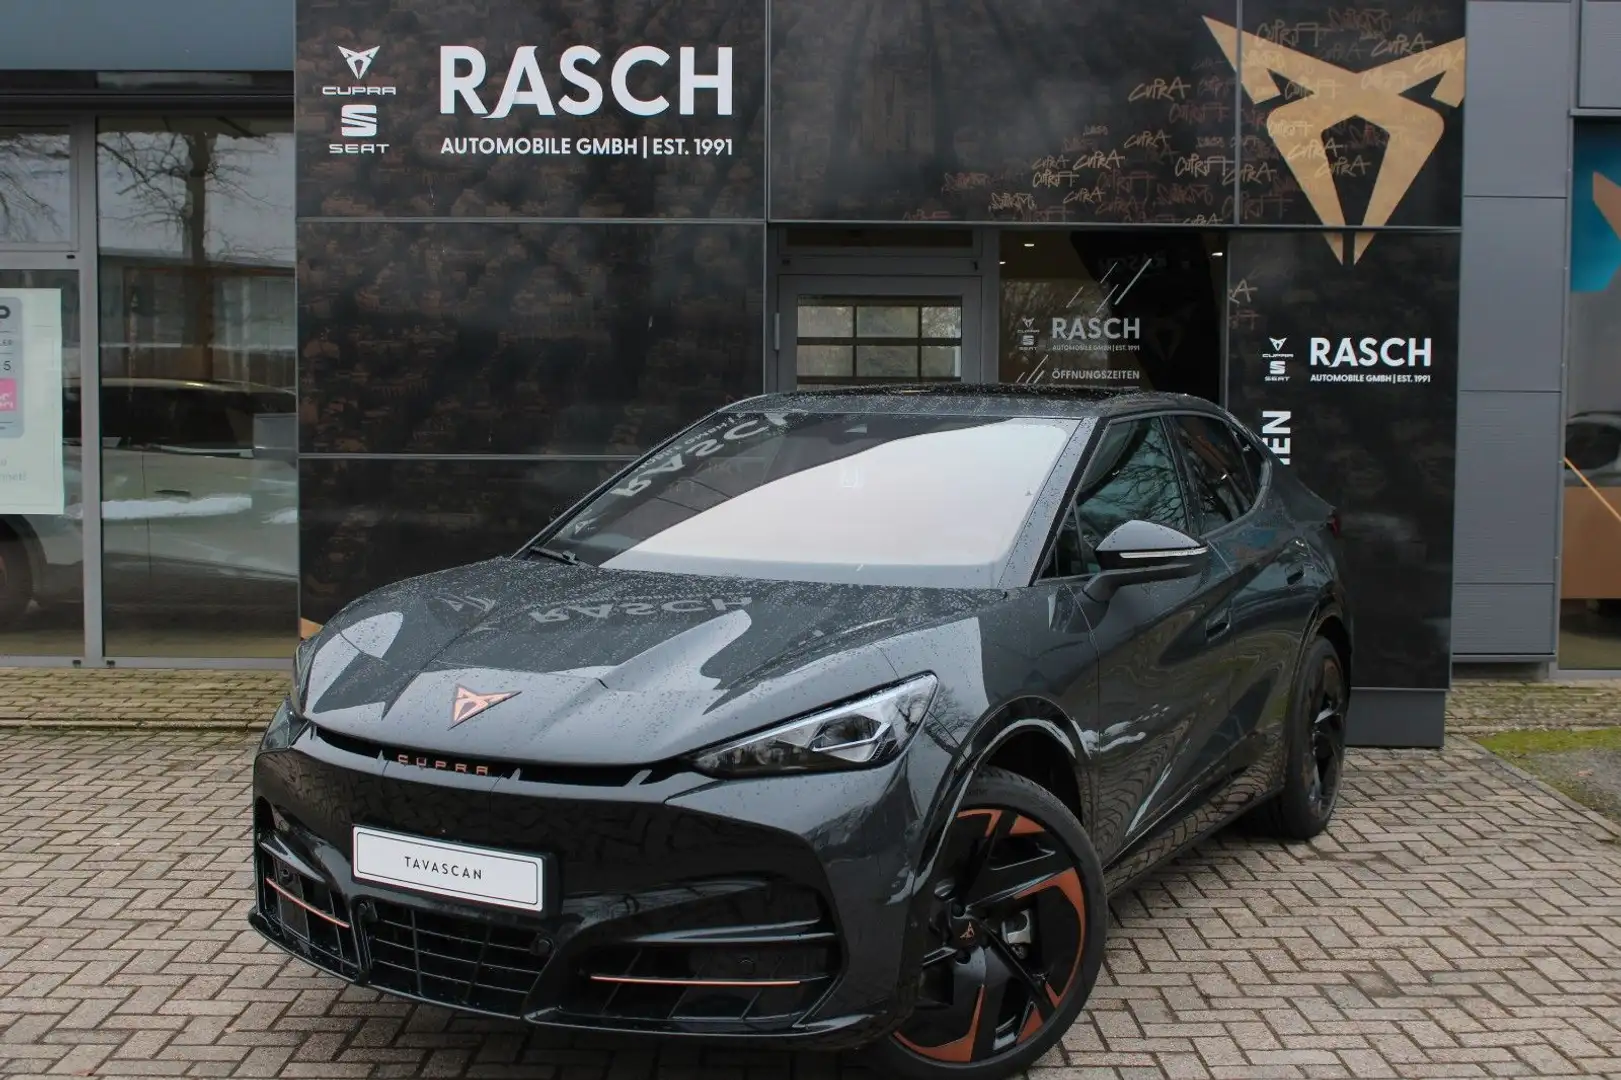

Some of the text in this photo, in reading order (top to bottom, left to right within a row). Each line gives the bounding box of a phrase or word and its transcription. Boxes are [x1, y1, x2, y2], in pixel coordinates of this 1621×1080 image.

[322, 86, 396, 95] CUPRA
[440, 45, 733, 118] RASCH
[1128, 76, 1191, 102] CUPRA
[329, 143, 389, 154] SEAT
[441, 137, 571, 155] AUTOMOBILE
[576, 137, 638, 155] GMBH
[653, 137, 690, 155] EST.
[694, 137, 733, 155] 1991
[1124, 130, 1172, 149] CUPRA
[1073, 150, 1125, 171] CUPRA
[1052, 317, 1140, 340] RASCH
[1310, 337, 1432, 368] RASCH
[1051, 367, 1140, 380] ÖFFNUNGSZEITEN
[1310, 374, 1364, 383] AUTOMOBILE
[1366, 374, 1392, 383] GMBH
[1397, 374, 1413, 383] EST.
[1415, 374, 1431, 383] 1991
[398, 754, 488, 775] CUPRA
[404, 856, 482, 880] TAVASCAN
